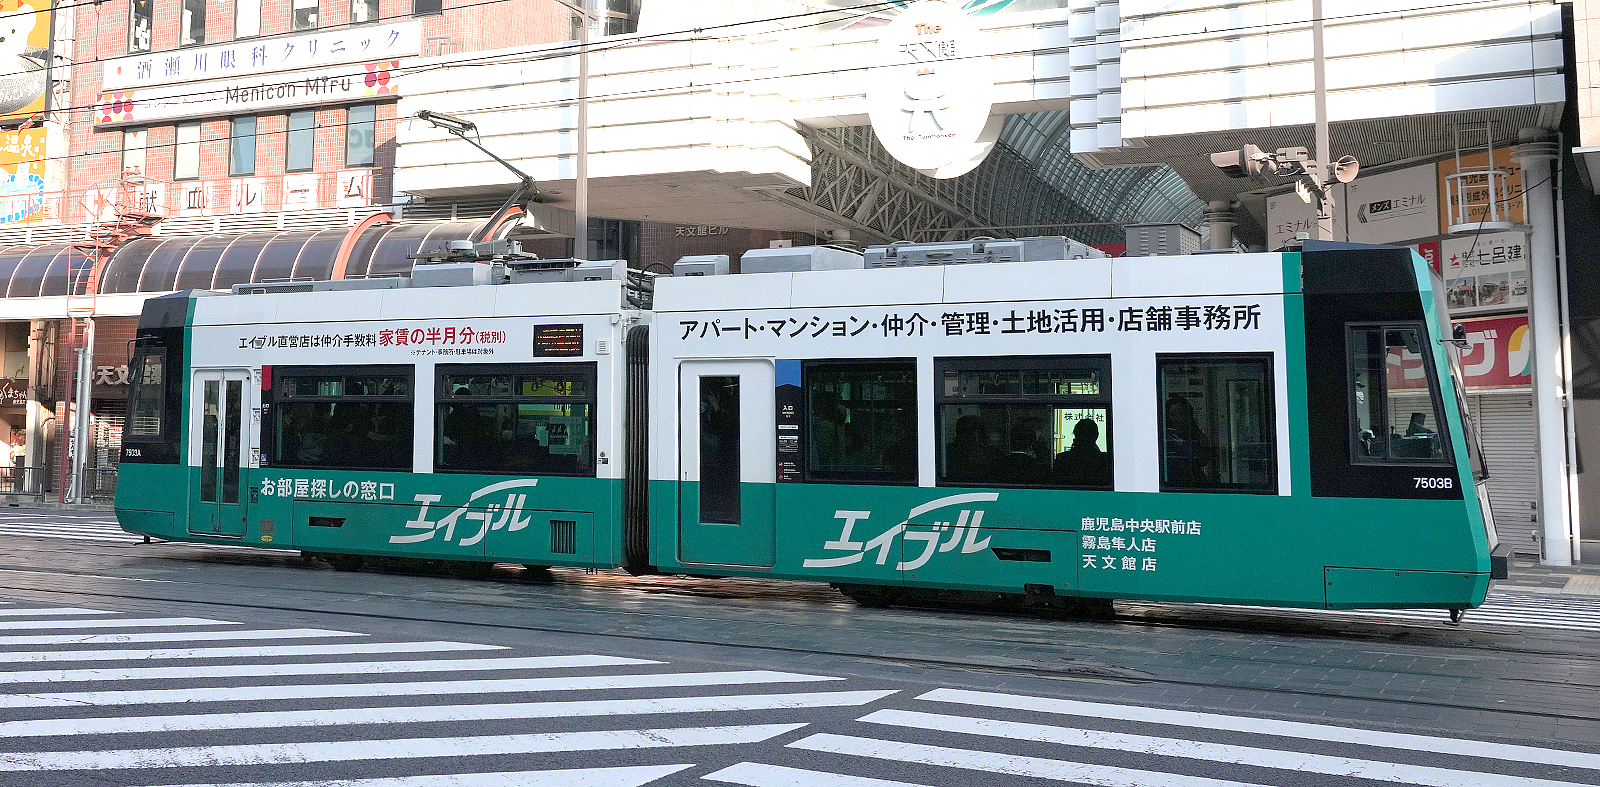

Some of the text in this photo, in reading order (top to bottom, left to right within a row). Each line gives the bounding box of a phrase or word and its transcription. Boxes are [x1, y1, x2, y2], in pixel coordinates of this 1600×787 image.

[225, 81, 296, 104] Menicon
[674, 225, 729, 237] 天文館ビル
[1476, 244, 1526, 266] 七呂建
[679, 303, 1262, 341] アパート・マンション・仲介・管理・土地活用・店舗事務所
[260, 476, 395, 501] お部屋探しの窓口
[1413, 477, 1453, 489] 7503B
[388, 478, 539, 547] エイブル
[802, 492, 1000, 571] エイブル
[1080, 516, 1202, 535] 鹿児島中央駅前店
[1081, 534, 1157, 553] 霧島隼人店
[1082, 554, 1157, 572] 天文館店
